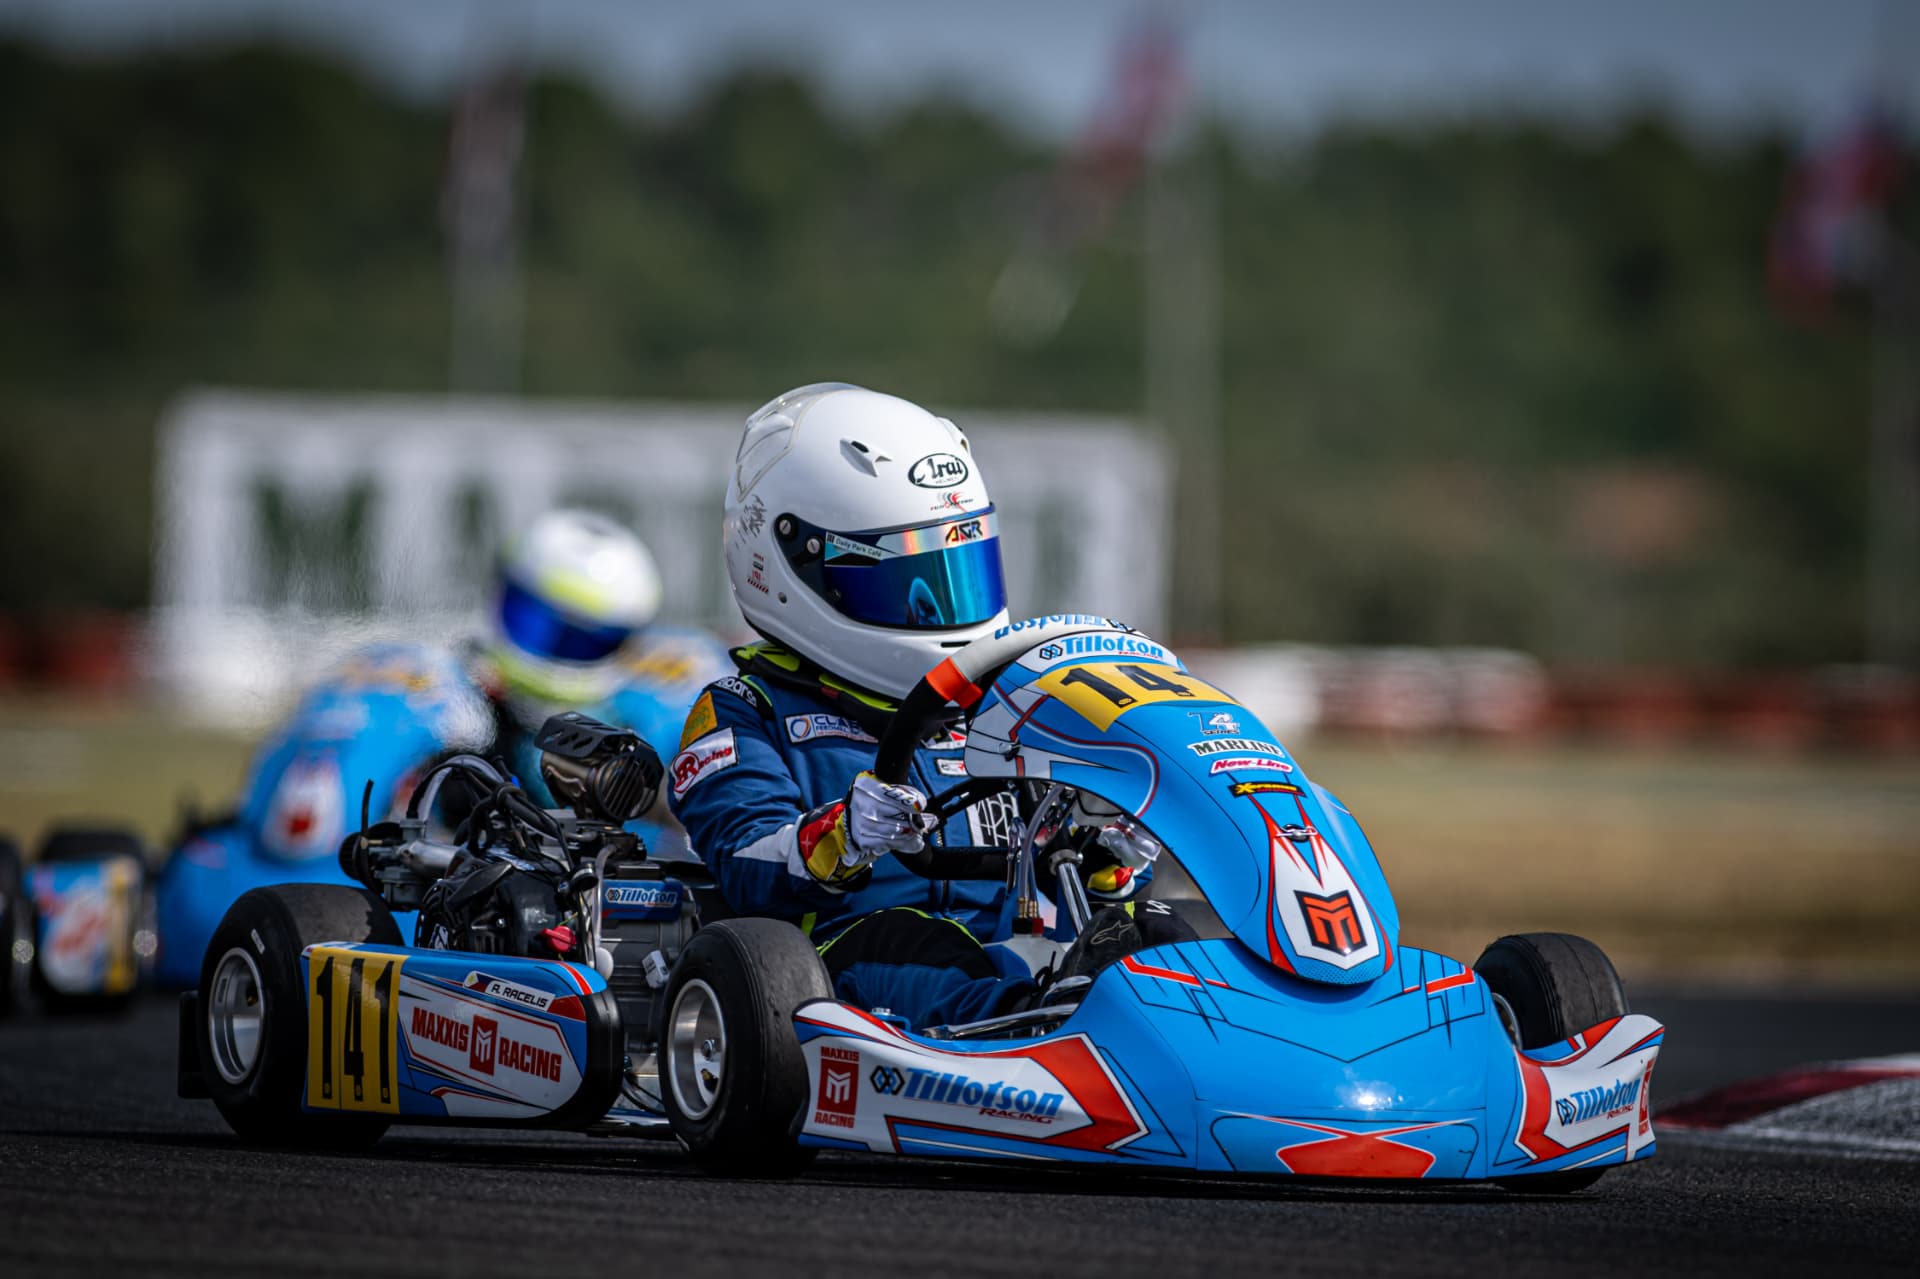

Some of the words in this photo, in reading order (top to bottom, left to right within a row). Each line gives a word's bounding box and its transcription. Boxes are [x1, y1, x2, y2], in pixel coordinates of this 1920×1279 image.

[910, 455, 966, 482] Arai
[1060, 635, 1163, 659] Tillotson
[620, 888, 677, 903] Tillotson
[502, 986, 548, 1008] RACELIS
[316, 956, 395, 1104] 141
[411, 1007, 470, 1053] MAXXIS
[498, 1036, 562, 1083] RACING
[820, 1046, 860, 1063] MAXXIS
[903, 1067, 1064, 1116] Tillotson
[1570, 1078, 1641, 1122] Tillotson
[814, 1112, 855, 1129] RACING
[979, 1107, 1053, 1124] RACING
